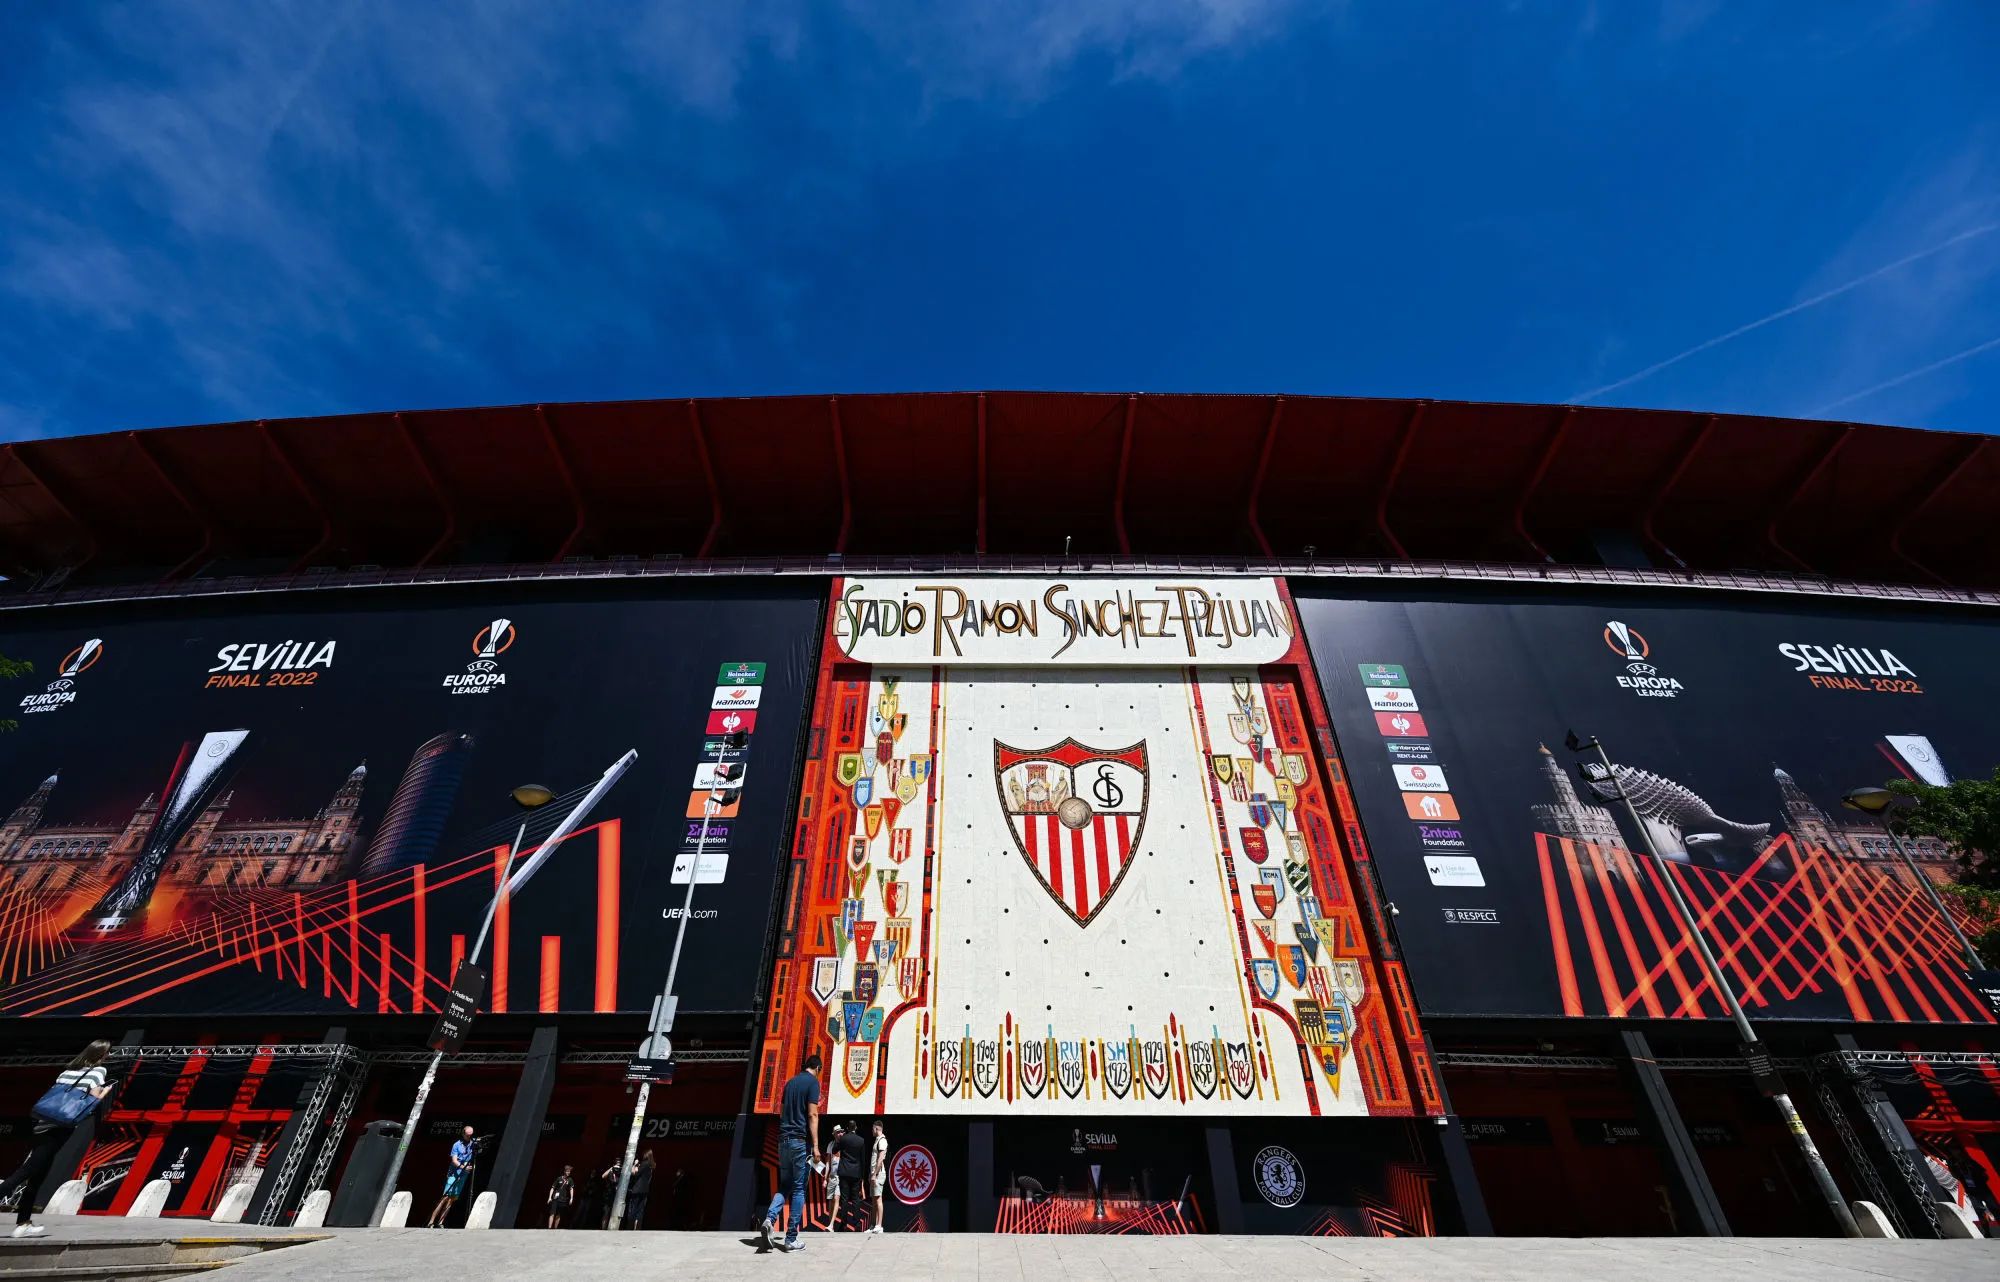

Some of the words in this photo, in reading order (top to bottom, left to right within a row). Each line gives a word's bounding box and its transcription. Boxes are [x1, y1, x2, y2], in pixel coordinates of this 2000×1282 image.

[915, 586, 1039, 657] RAMON
[468, 661, 495, 671] UEFA
[1628, 664, 1656, 675] UEFA
[204, 674, 260, 688] FINAL
[266, 672, 319, 686] 2022
[442, 673, 506, 686] EUROPA
[1616, 676, 1684, 690] EUROPA
[1808, 675, 1871, 690] FINAL
[1870, 678, 1924, 694] 2022
[452, 686, 491, 694] LEAGUE
[1636, 689, 1677, 697] LEAGUE
[19, 691, 77, 707] EUROPA
[24, 704, 60, 713] LEAGUE
[685, 836, 727, 844] Foudation
[1422, 838, 1465, 846] Foundation
[1457, 911, 1497, 921] RESPECT
[976, 1039, 996, 1062] 1908
[1023, 1040, 1043, 1063] 1910
[1143, 1041, 1164, 1064] 1929
[1190, 1041, 1211, 1063] 1958
[854, 1062, 863, 1072] 12
[1060, 1060, 1081, 1088] 1918
[1107, 1062, 1128, 1087] 1923
[1229, 1060, 1250, 1087] 1982
[645, 1118, 671, 1138] 29
[675, 1121, 699, 1131] GATE
[1471, 1124, 1506, 1134] PUERTA
[1257, 1148, 1297, 1166] RANGERS
[1258, 1180, 1294, 1205] FOOTBALL
[1291, 1180, 1303, 1201] CLUB
